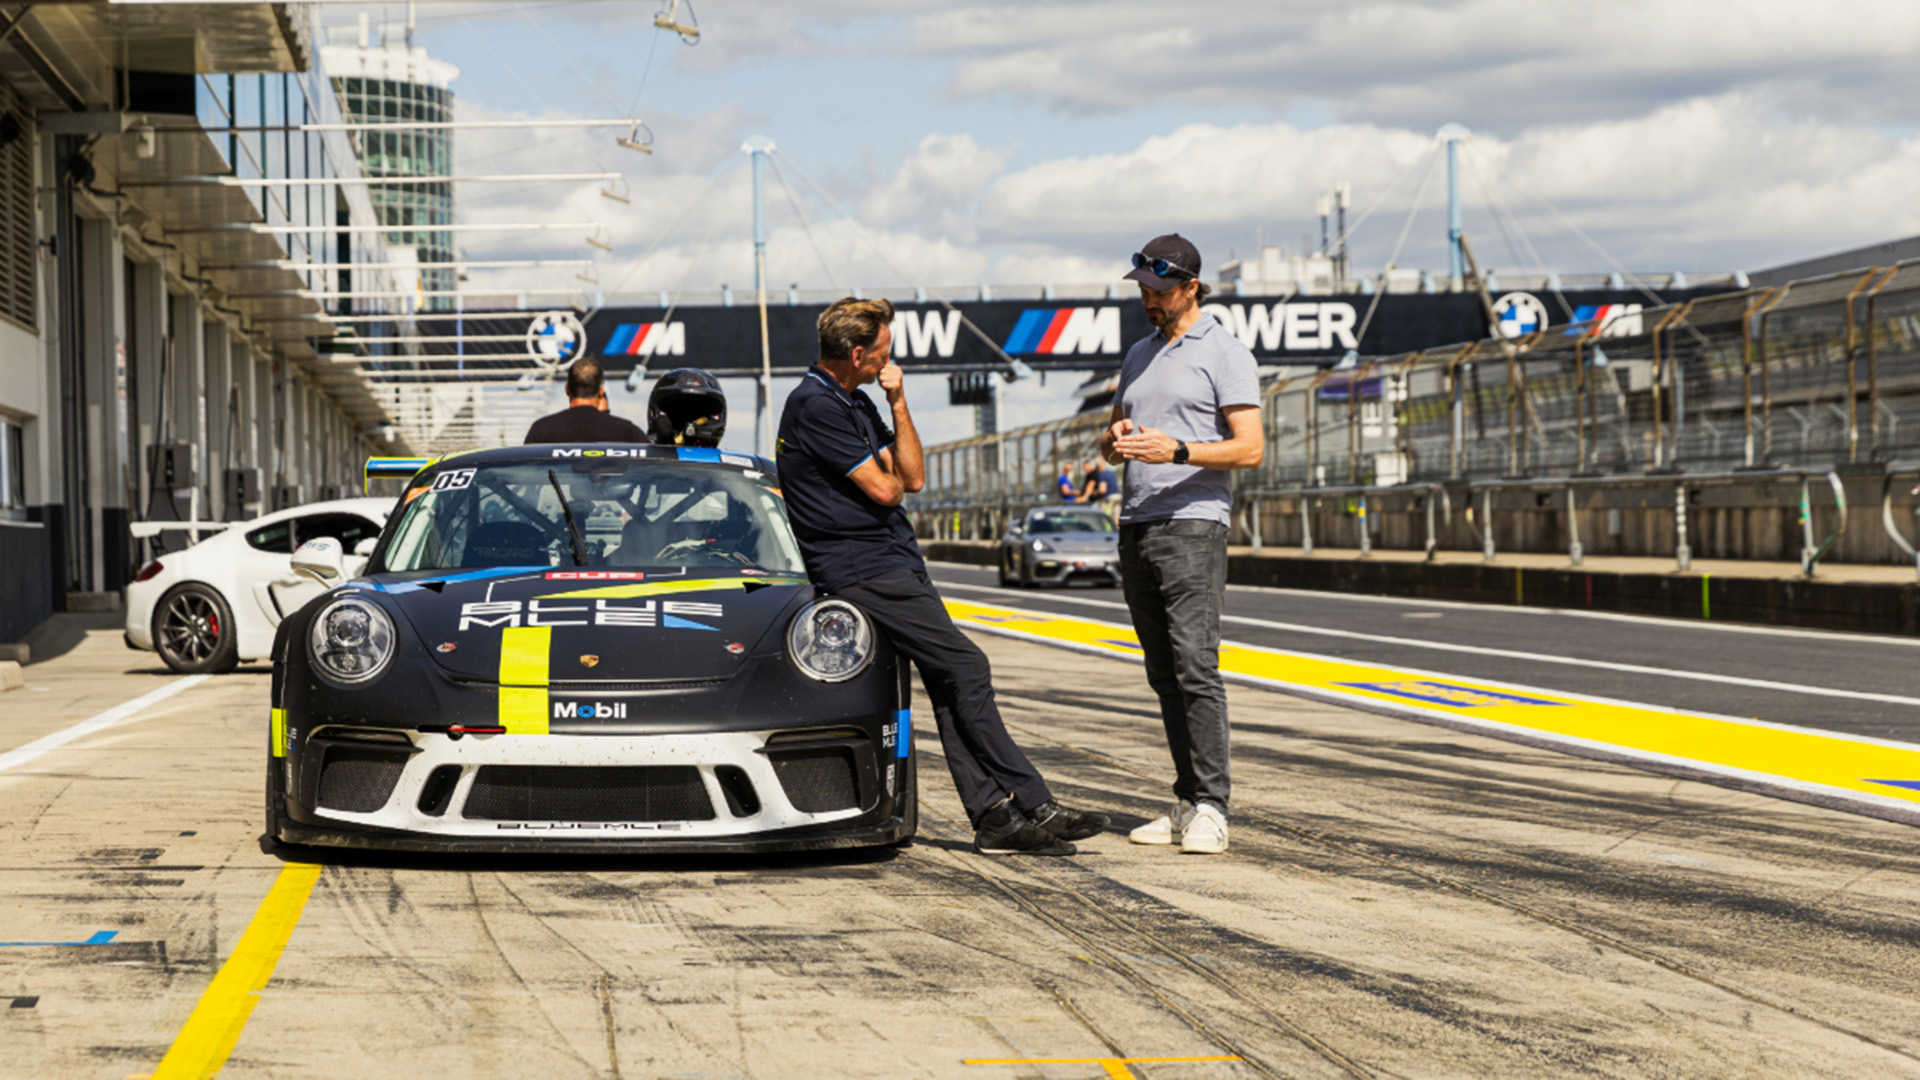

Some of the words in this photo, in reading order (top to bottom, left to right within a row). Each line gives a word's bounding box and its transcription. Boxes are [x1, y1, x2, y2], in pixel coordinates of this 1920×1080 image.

[1199, 302, 1359, 351] OWER
[552, 449, 646, 458] Mobil
[432, 469, 473, 491] 05
[551, 571, 637, 580] CUP
[461, 599, 723, 617] BLUE
[553, 702, 627, 719] Mobil
[497, 823, 681, 831] BLUEMLE
